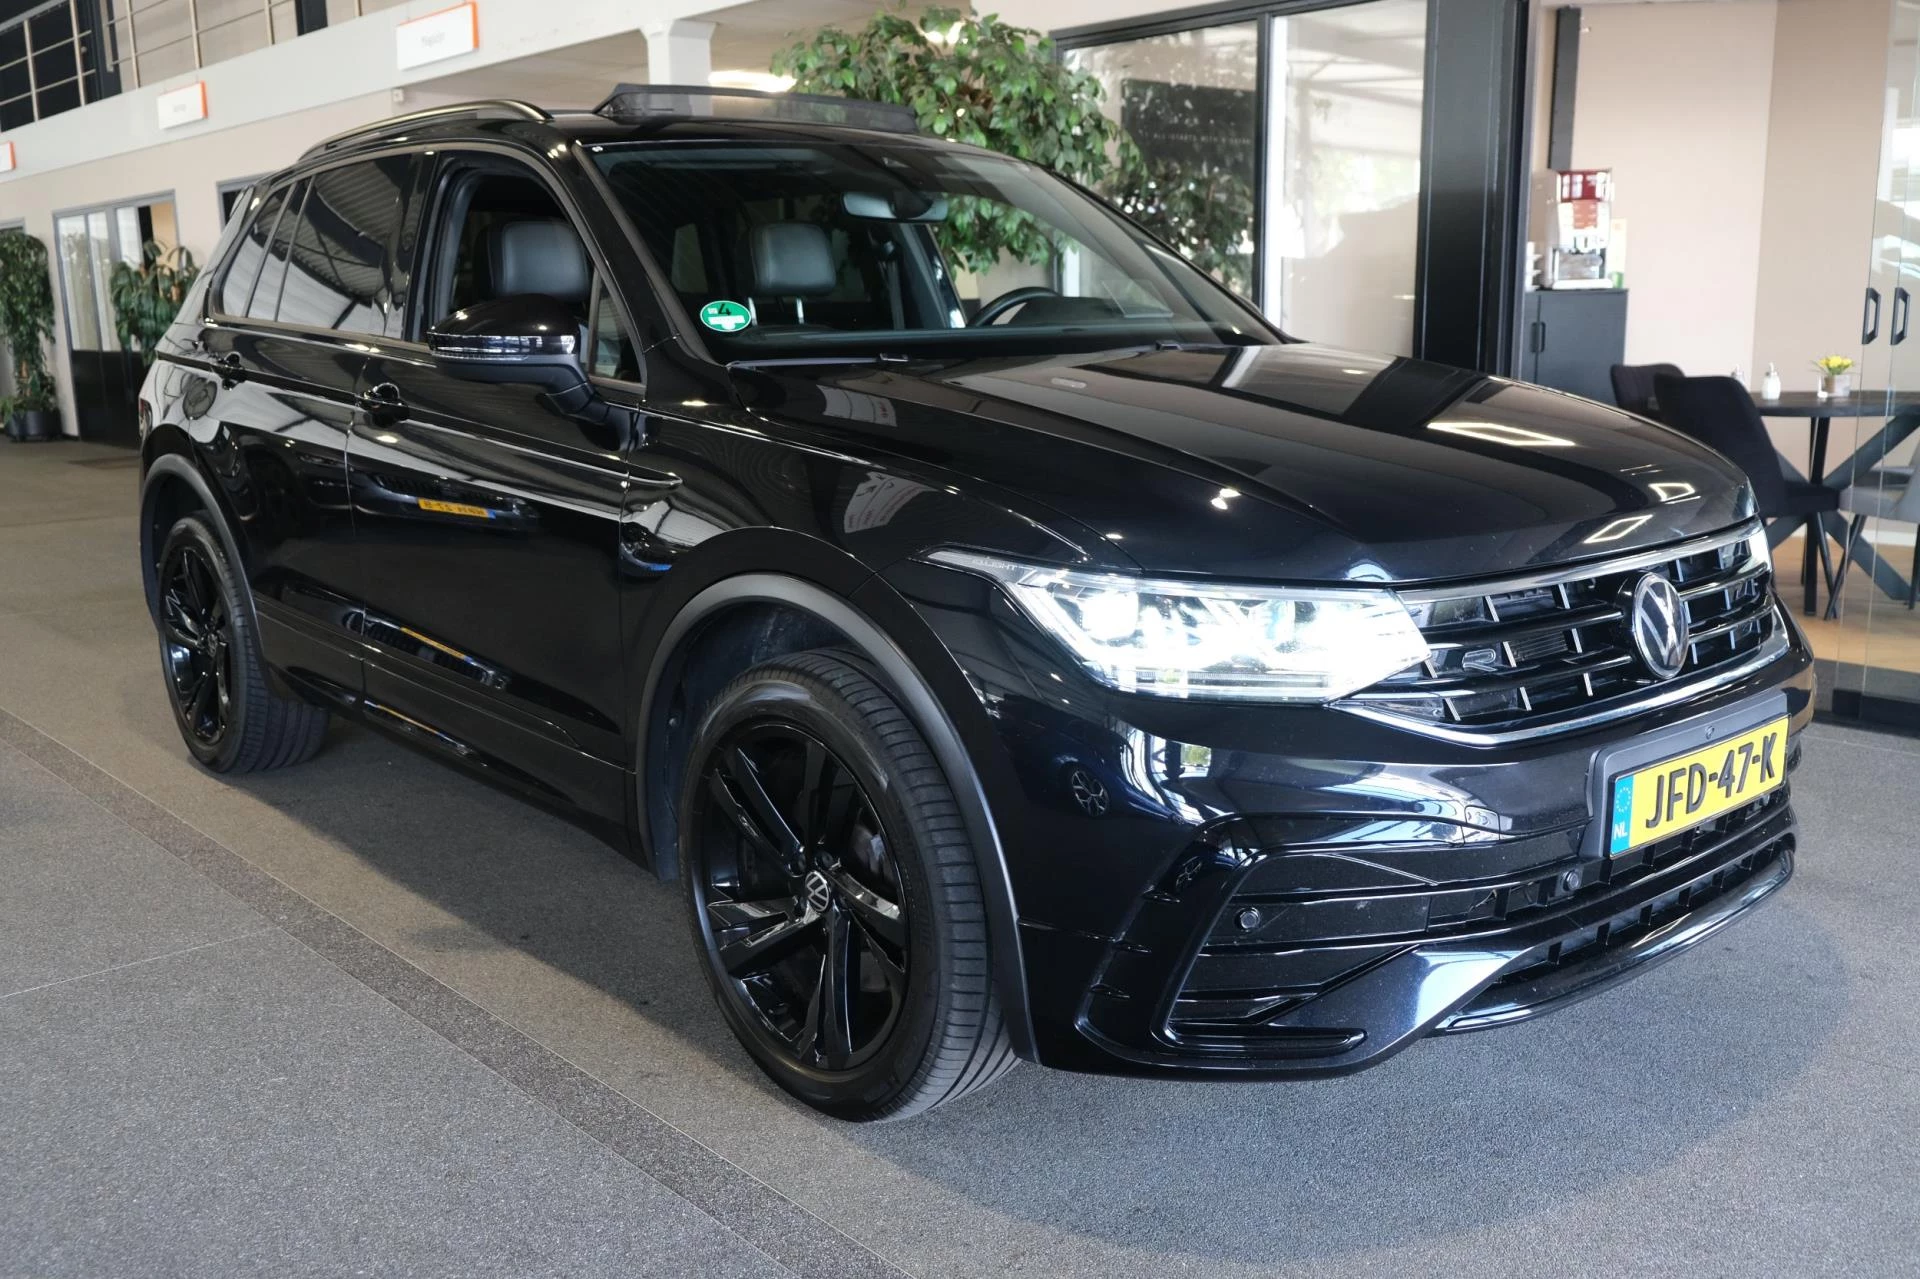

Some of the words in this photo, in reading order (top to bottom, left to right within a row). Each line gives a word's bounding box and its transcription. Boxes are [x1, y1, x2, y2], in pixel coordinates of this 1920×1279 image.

[717, 303, 732, 316] 4
[1645, 732, 1778, 829] JFD-47-K
[1613, 823, 1628, 841] NL
